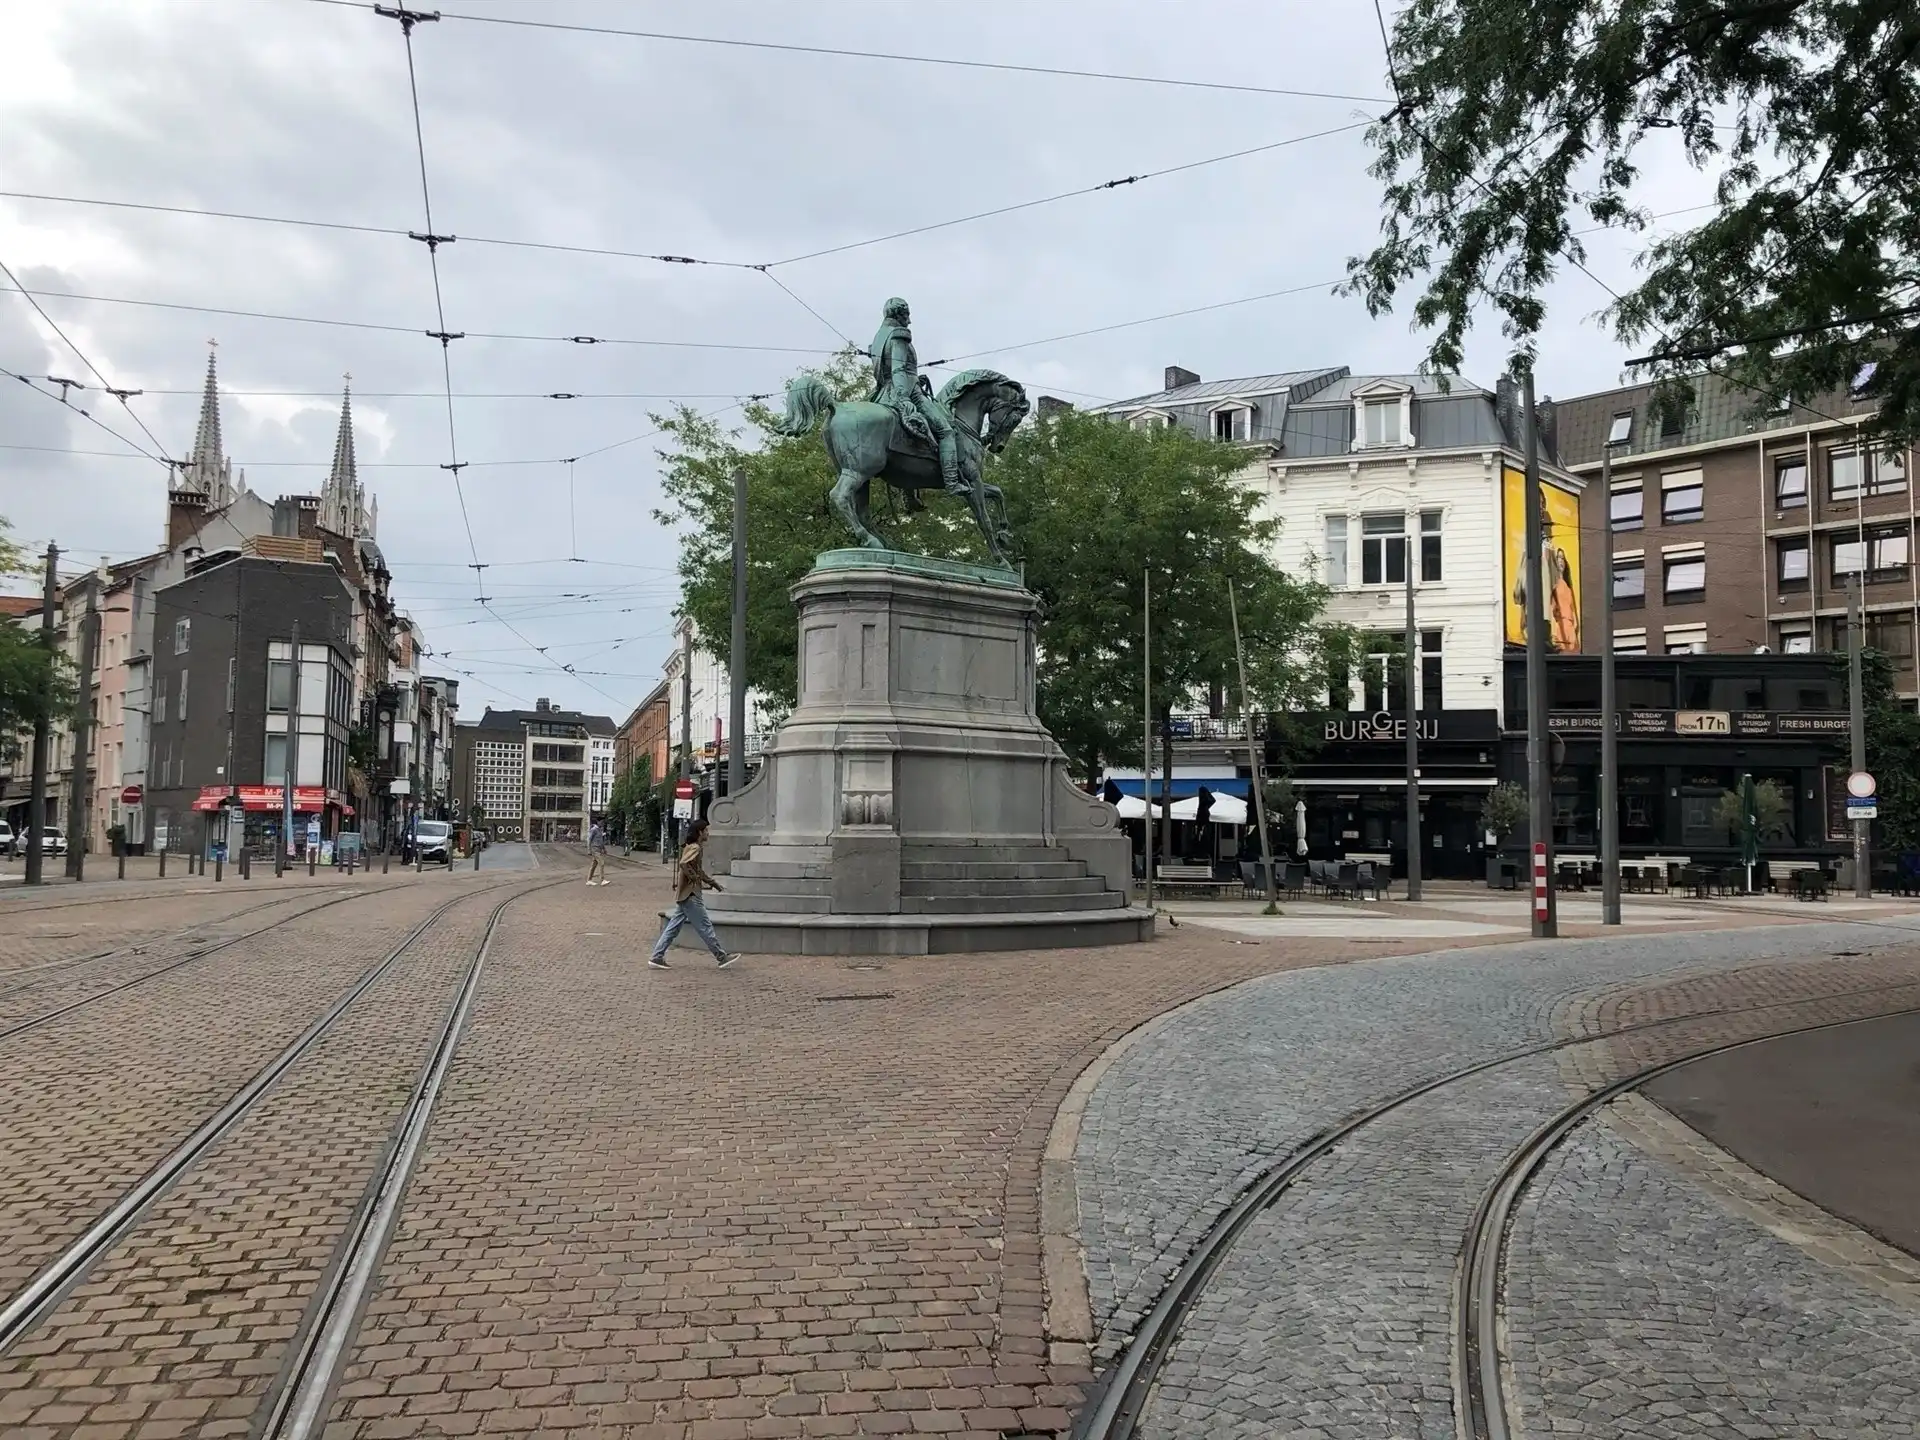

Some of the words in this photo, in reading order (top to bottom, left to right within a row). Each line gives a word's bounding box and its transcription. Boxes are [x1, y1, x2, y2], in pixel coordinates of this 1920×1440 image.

[1325, 711, 1438, 740] BURGERIJ
[1549, 718, 1568, 727] ESH
[1570, 718, 1618, 727] BURGE
[1679, 723, 1697, 731] FROM
[1695, 716, 1726, 731] 17h
[1779, 720, 1810, 729] FRESH
[1813, 720, 1852, 729] BURGER
[264, 788, 300, 796] M-PS
